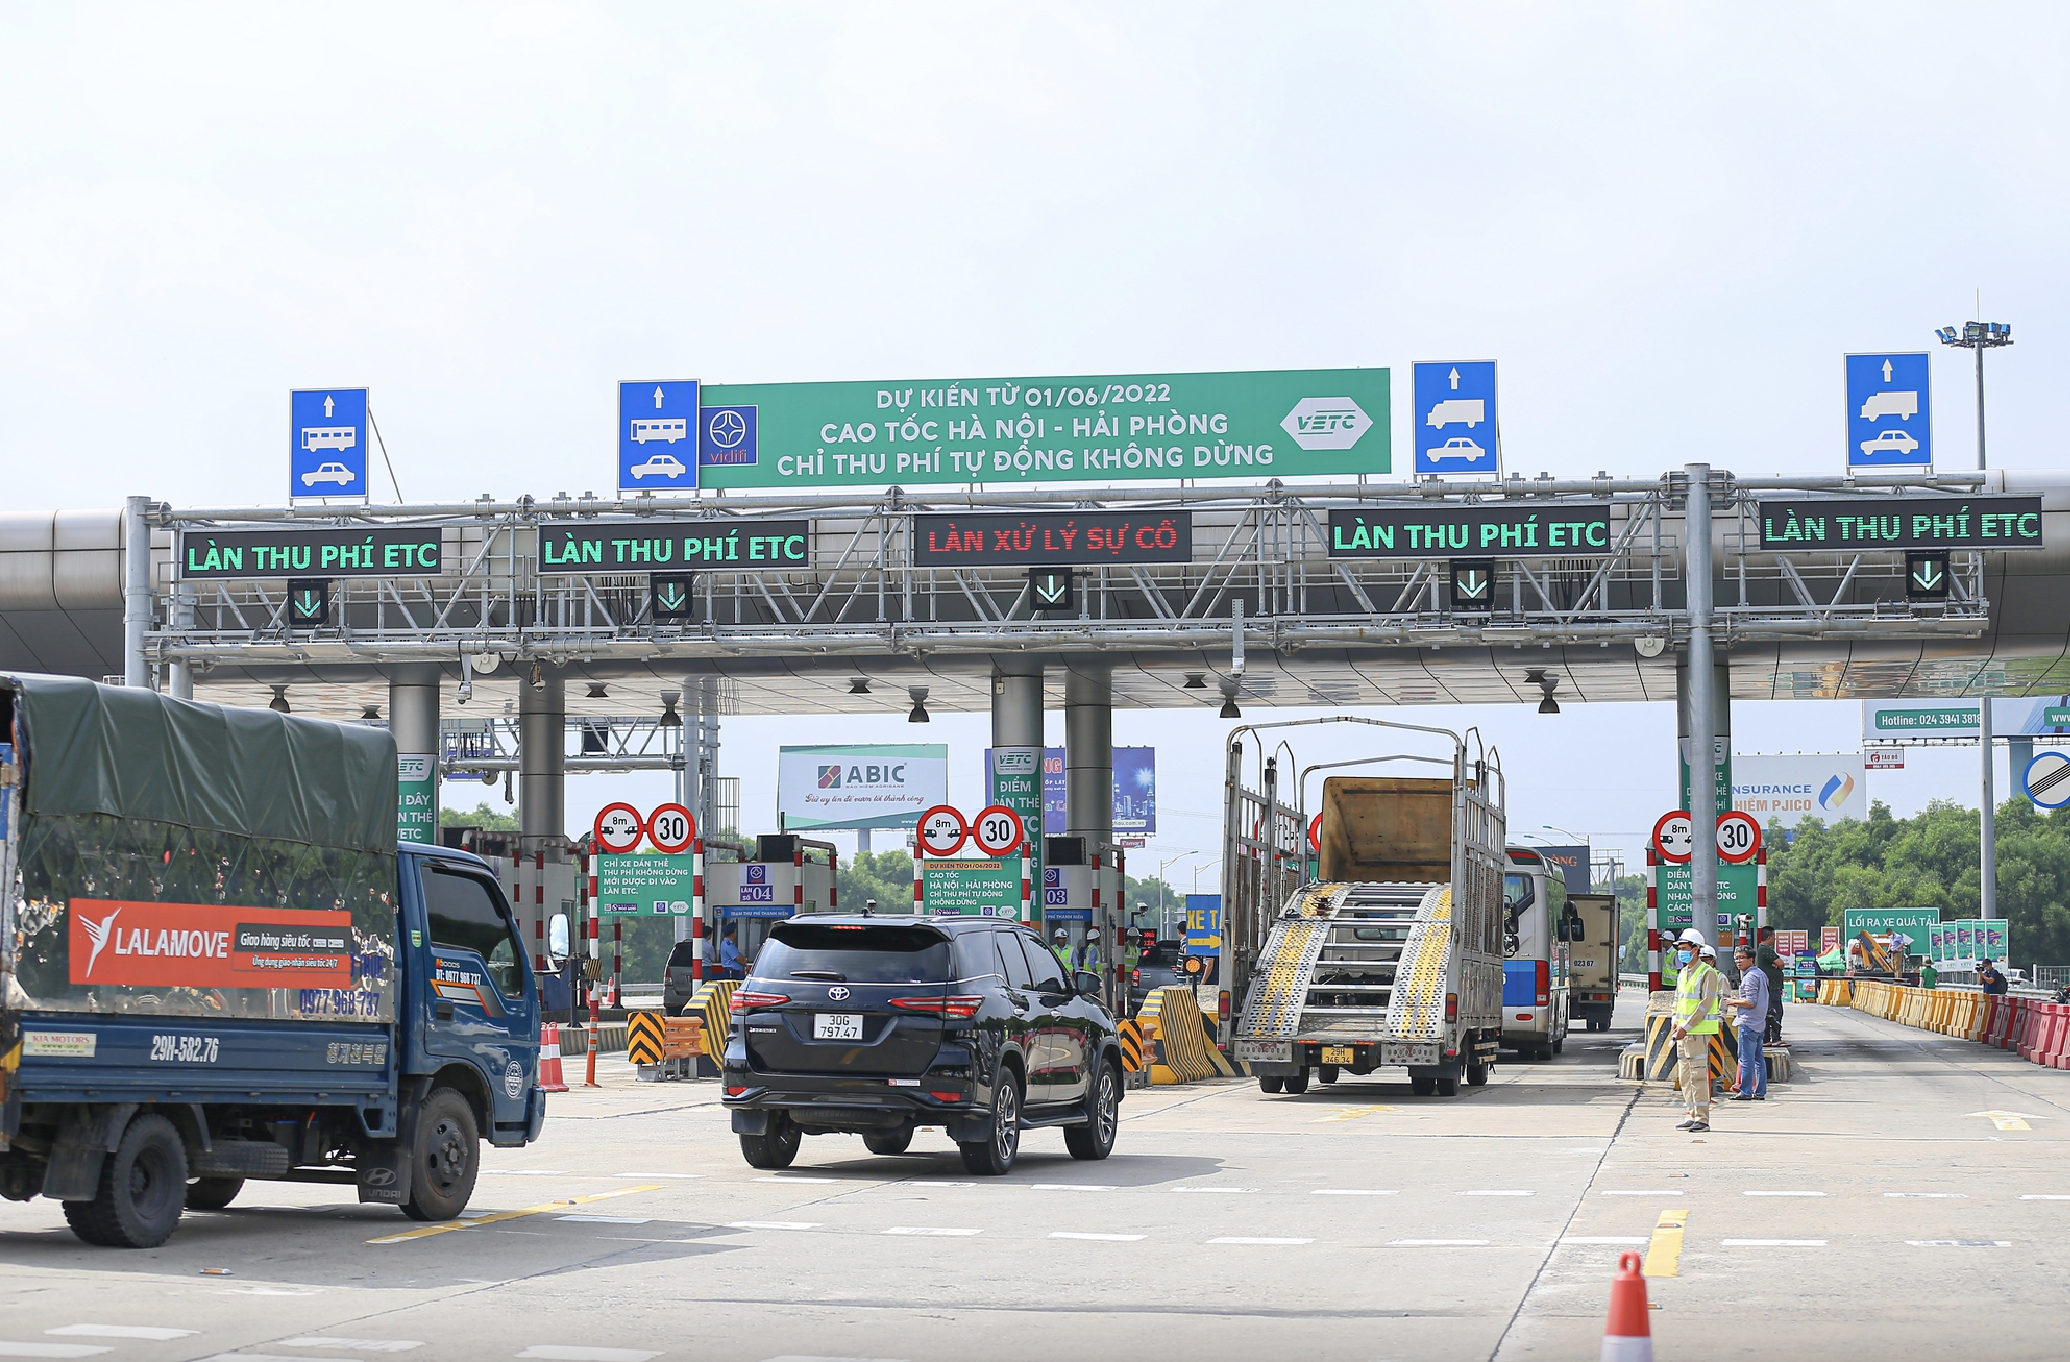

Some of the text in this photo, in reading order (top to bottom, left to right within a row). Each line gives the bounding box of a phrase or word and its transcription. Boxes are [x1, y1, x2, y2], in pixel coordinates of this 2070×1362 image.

[877, 382, 1170, 413] DỰ KIẾN TỪ 01/06/2022
[821, 422, 877, 444] CAO
[884, 413, 939, 443] TỐC
[949, 413, 987, 440] HÀ
[995, 413, 1044, 445] NỘI
[1073, 410, 1119, 438] HẢI
[1129, 408, 1229, 436] PHÒNG
[1296, 412, 1357, 433] VETC
[709, 449, 747, 464] vidifi
[777, 439, 1274, 477] CHỈ THU PHÍ TỰ ĐỘNG KHÔNG DỪNG
[1764, 505, 2039, 542] LÀN THU PHÍ ETC
[929, 519, 1177, 555] LÀN XỬ LÝ SỰ CỐ
[1333, 513, 1607, 550] LÀN THU PHÍ ETC
[544, 528, 805, 564] LÀN THU PHÍ ETC
[188, 535, 437, 572] LÀN THU PHÍ ETC
[1882, 715, 1917, 727] Hotline:
[1919, 714, 1937, 725] 024
[1939, 713, 1960, 724] 3941
[1000, 753, 1031, 765] VETC
[398, 762, 424, 772] ETC
[846, 765, 905, 783] ABIC
[1000, 776, 1031, 792] ĐIỂM
[1732, 785, 1811, 794] NSURANCE
[405, 792, 430, 805] ĐÂY
[1019, 794, 1040, 808] THẺ
[1734, 796, 1812, 812] HIỂM PJICO
[410, 808, 433, 823] THẺ
[613, 816, 628, 825] 8m
[659, 817, 684, 840] 30
[935, 819, 951, 828] 8m
[1671, 824, 1687, 833] 8m
[985, 820, 1010, 842] 30
[1723, 824, 1748, 848] 30
[633, 858, 651, 867] DÁN
[1550, 854, 1578, 867] ÒNG
[620, 868, 635, 876] PHÍ
[636, 868, 664, 876] KHÔNG
[946, 871, 960, 879] TỐC
[1667, 868, 1690, 879] ĐIỂM
[604, 877, 620, 886] MỚI
[660, 876, 677, 886] VÀO
[929, 879, 1013, 890] HÀ NỘI HẢI PHÒNG
[1667, 880, 1687, 890] DÁN
[604, 887, 619, 895] LÀN
[752, 887, 771, 900] 04
[1046, 890, 1066, 903] 03
[1667, 902, 1692, 912] CÁCH
[1186, 910, 1221, 929] XE T
[1849, 914, 1864, 927] LỐI
[1867, 918, 1880, 927] RA
[1882, 918, 1894, 927] XE
[1896, 915, 1917, 927] QUÁ
[114, 927, 230, 960] LALAMOVE
[240, 932, 259, 946] Giao
[260, 931, 280, 950] hàng
[280, 932, 297, 948] siêu
[297, 933, 311, 948] tốc
[300, 989, 380, 1016] 0977 968 737
[829, 1015, 850, 1026] 30G
[32, 1035, 90, 1044] KIA MOTORS
[820, 1027, 858, 1038] 797.47
[150, 1035, 219, 1063] 29H-582.76
